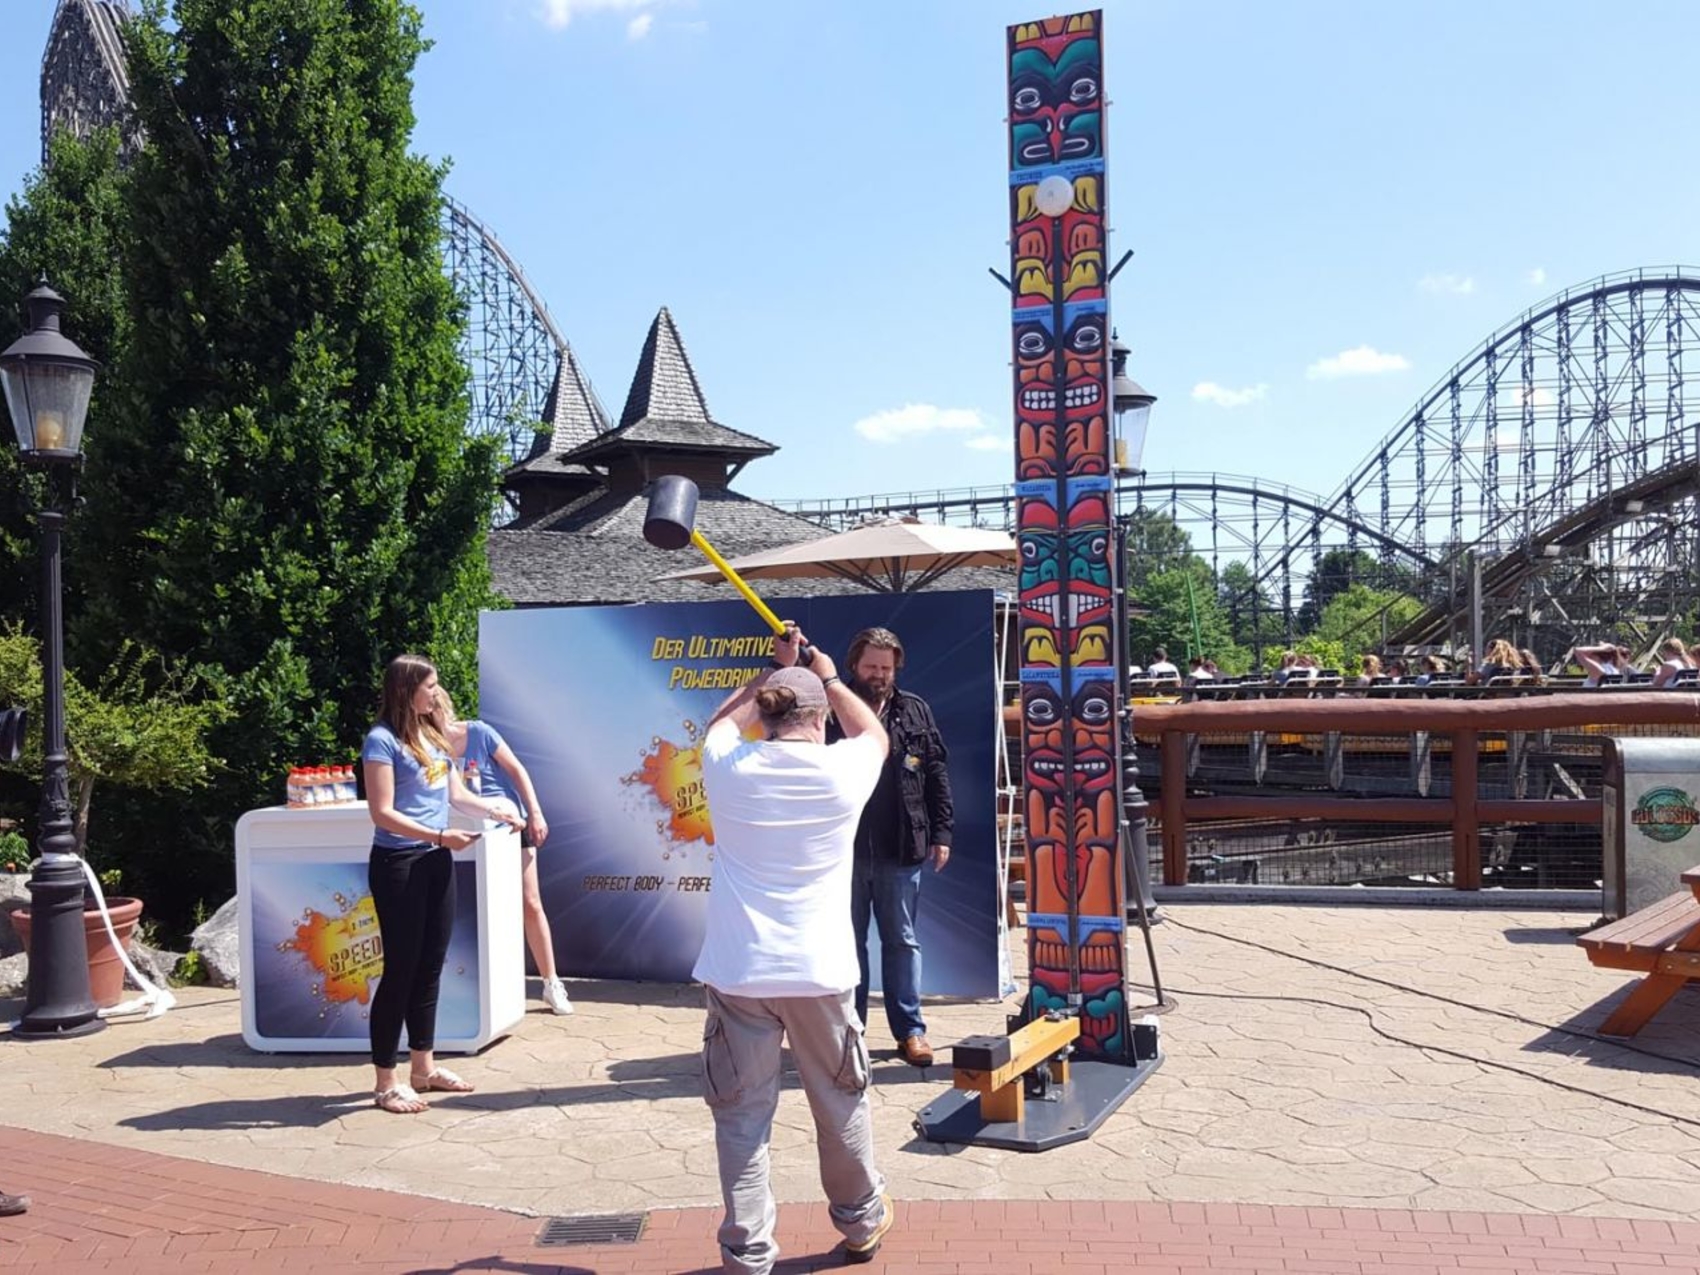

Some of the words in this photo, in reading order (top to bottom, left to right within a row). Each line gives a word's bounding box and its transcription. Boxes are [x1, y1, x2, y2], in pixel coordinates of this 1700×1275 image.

[652, 636, 684, 659] DER
[688, 635, 776, 658] ULTIMATIVE
[583, 876, 631, 891] PERFECT
[634, 876, 664, 891] BODY
[329, 935, 381, 973] SPEED
